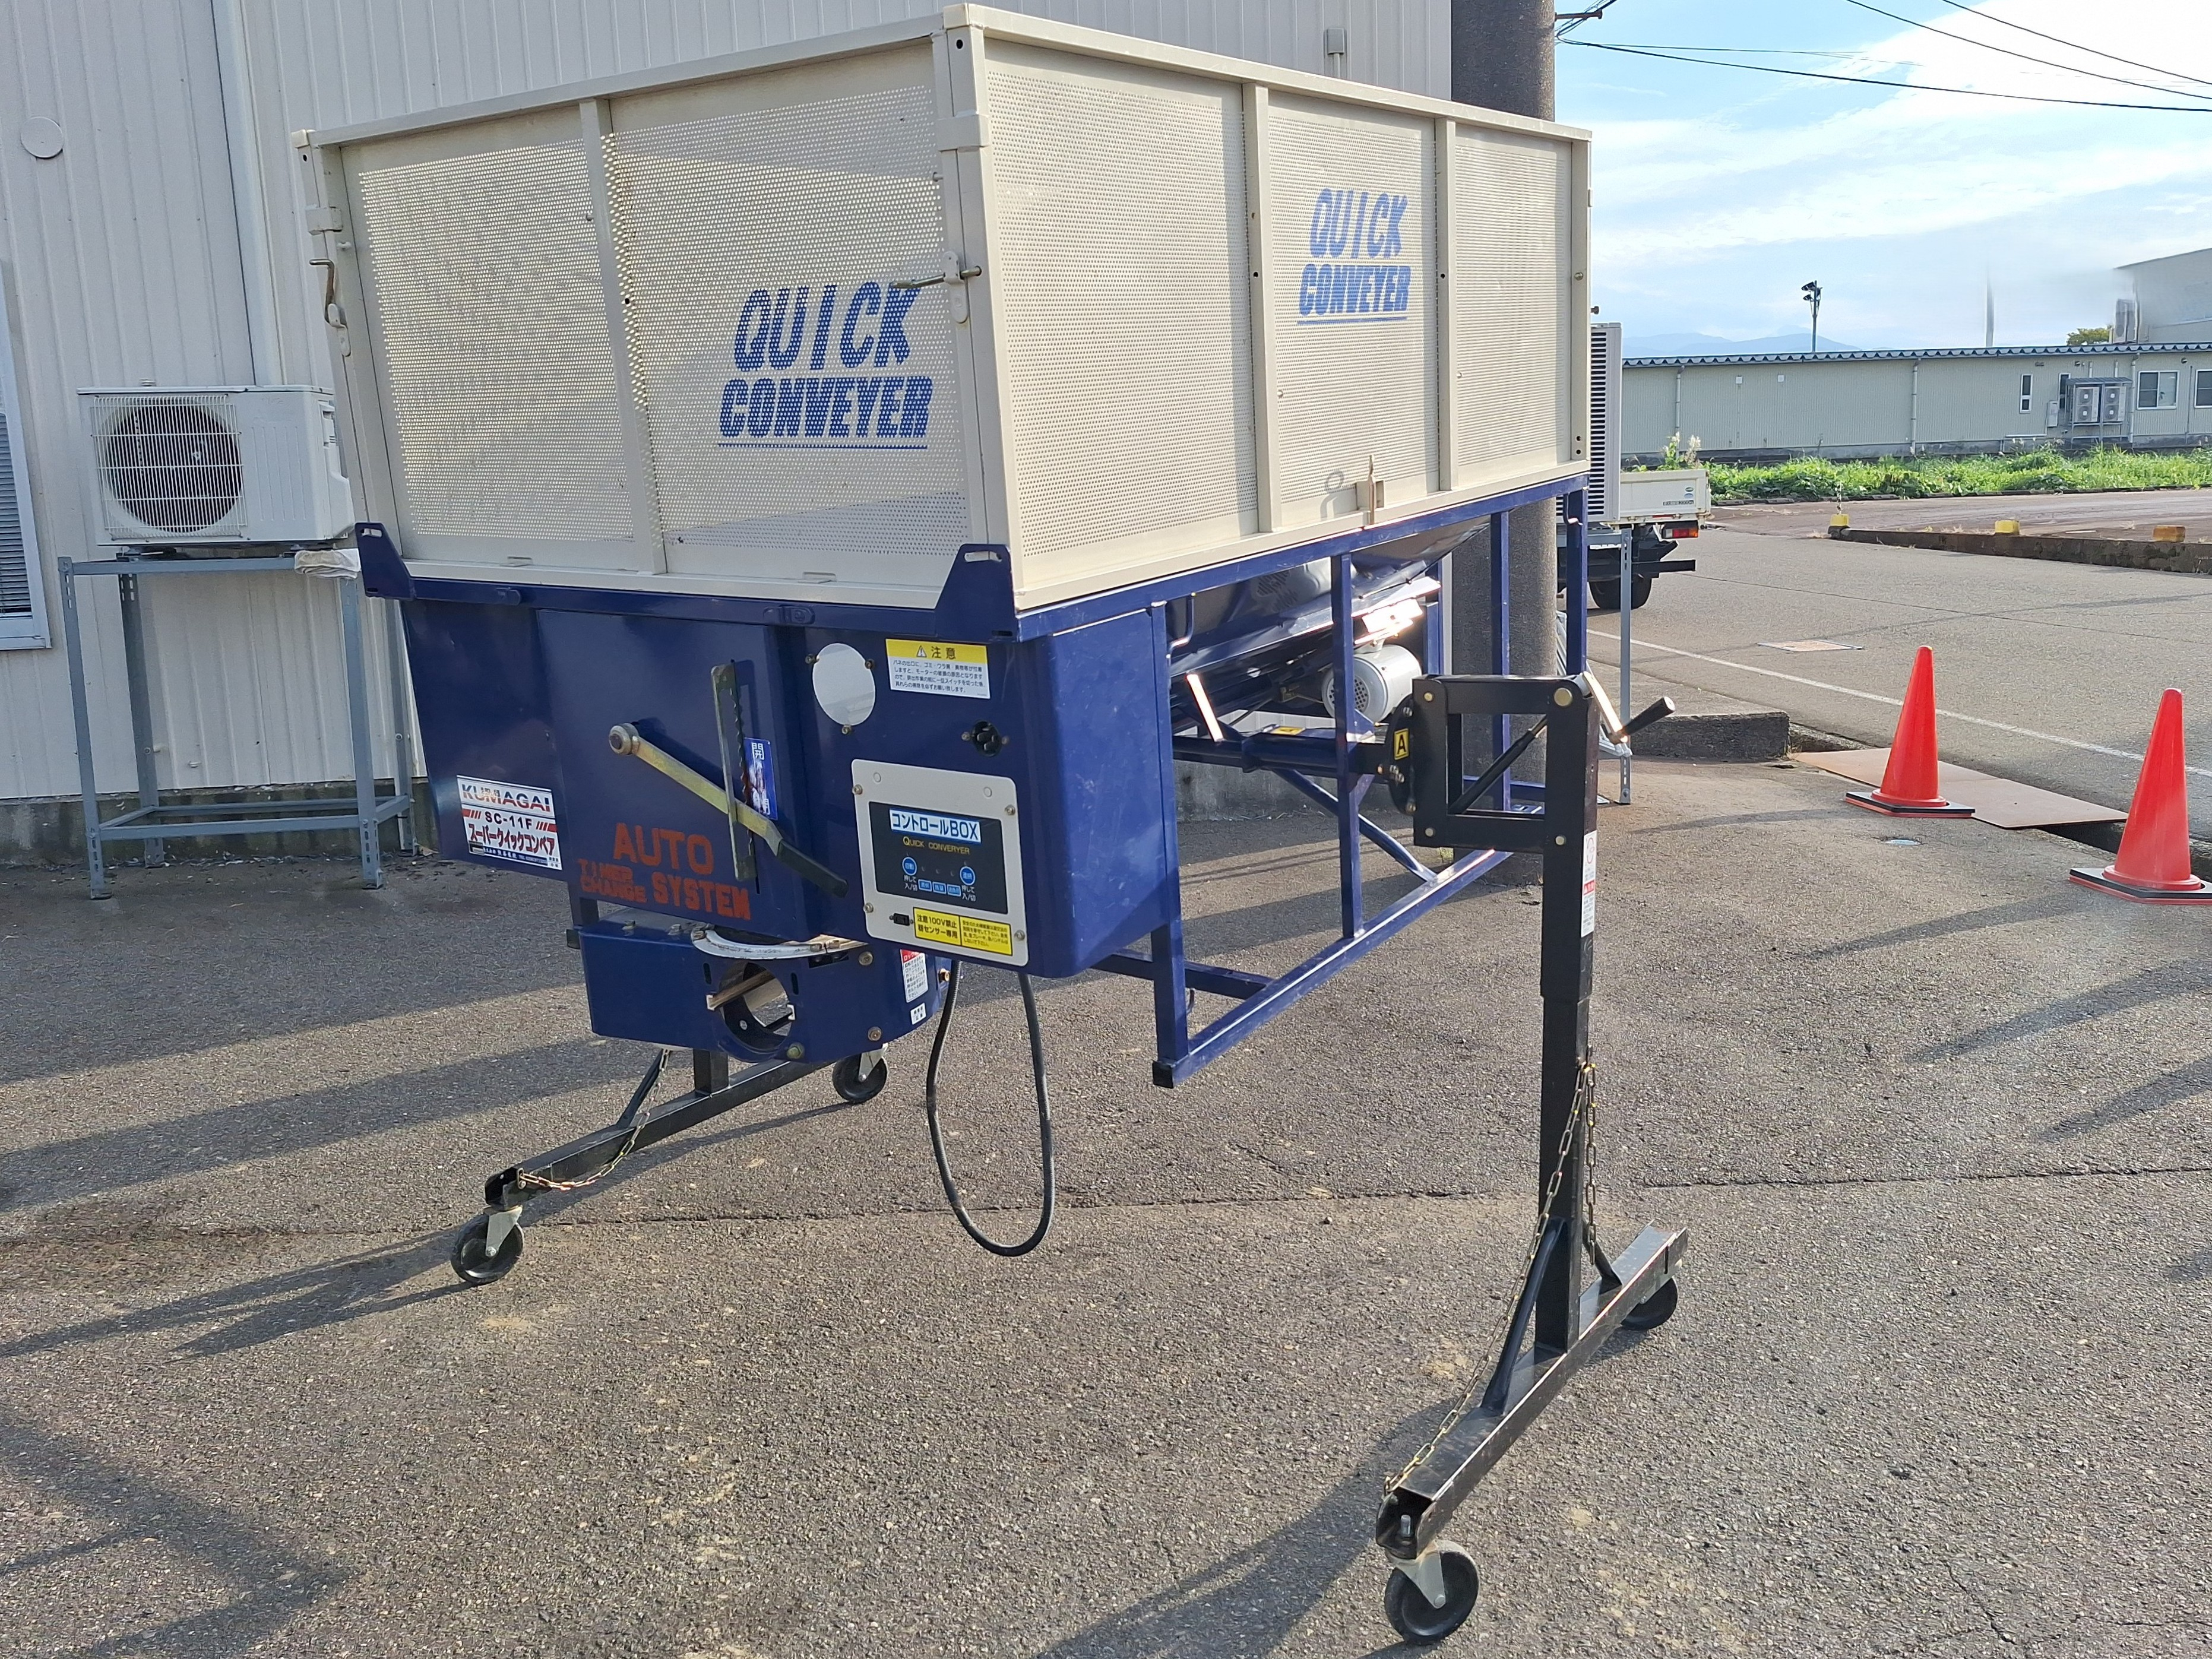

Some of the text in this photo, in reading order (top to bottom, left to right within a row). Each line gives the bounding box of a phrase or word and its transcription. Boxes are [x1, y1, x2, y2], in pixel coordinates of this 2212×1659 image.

[1309, 188, 1408, 259] QUICK
[1299, 264, 1411, 316] CONVEYER
[734, 281, 922, 372] QUICK
[719, 376, 933, 438] CONVEYER
[931, 646, 956, 660] 注意
[751, 742, 765, 760] 開
[1397, 734, 1406, 754] A
[462, 784, 550, 812] KUMAGAI
[485, 811, 532, 830] SC-11F
[892, 812, 979, 840] コントロールBOX
[469, 823, 555, 856] スーパークイックコンベア
[613, 822, 714, 875] AUTO
[903, 875, 917, 883] 押して
[961, 885, 975, 893] 押して
[651, 872, 751, 921] SYSTEM
